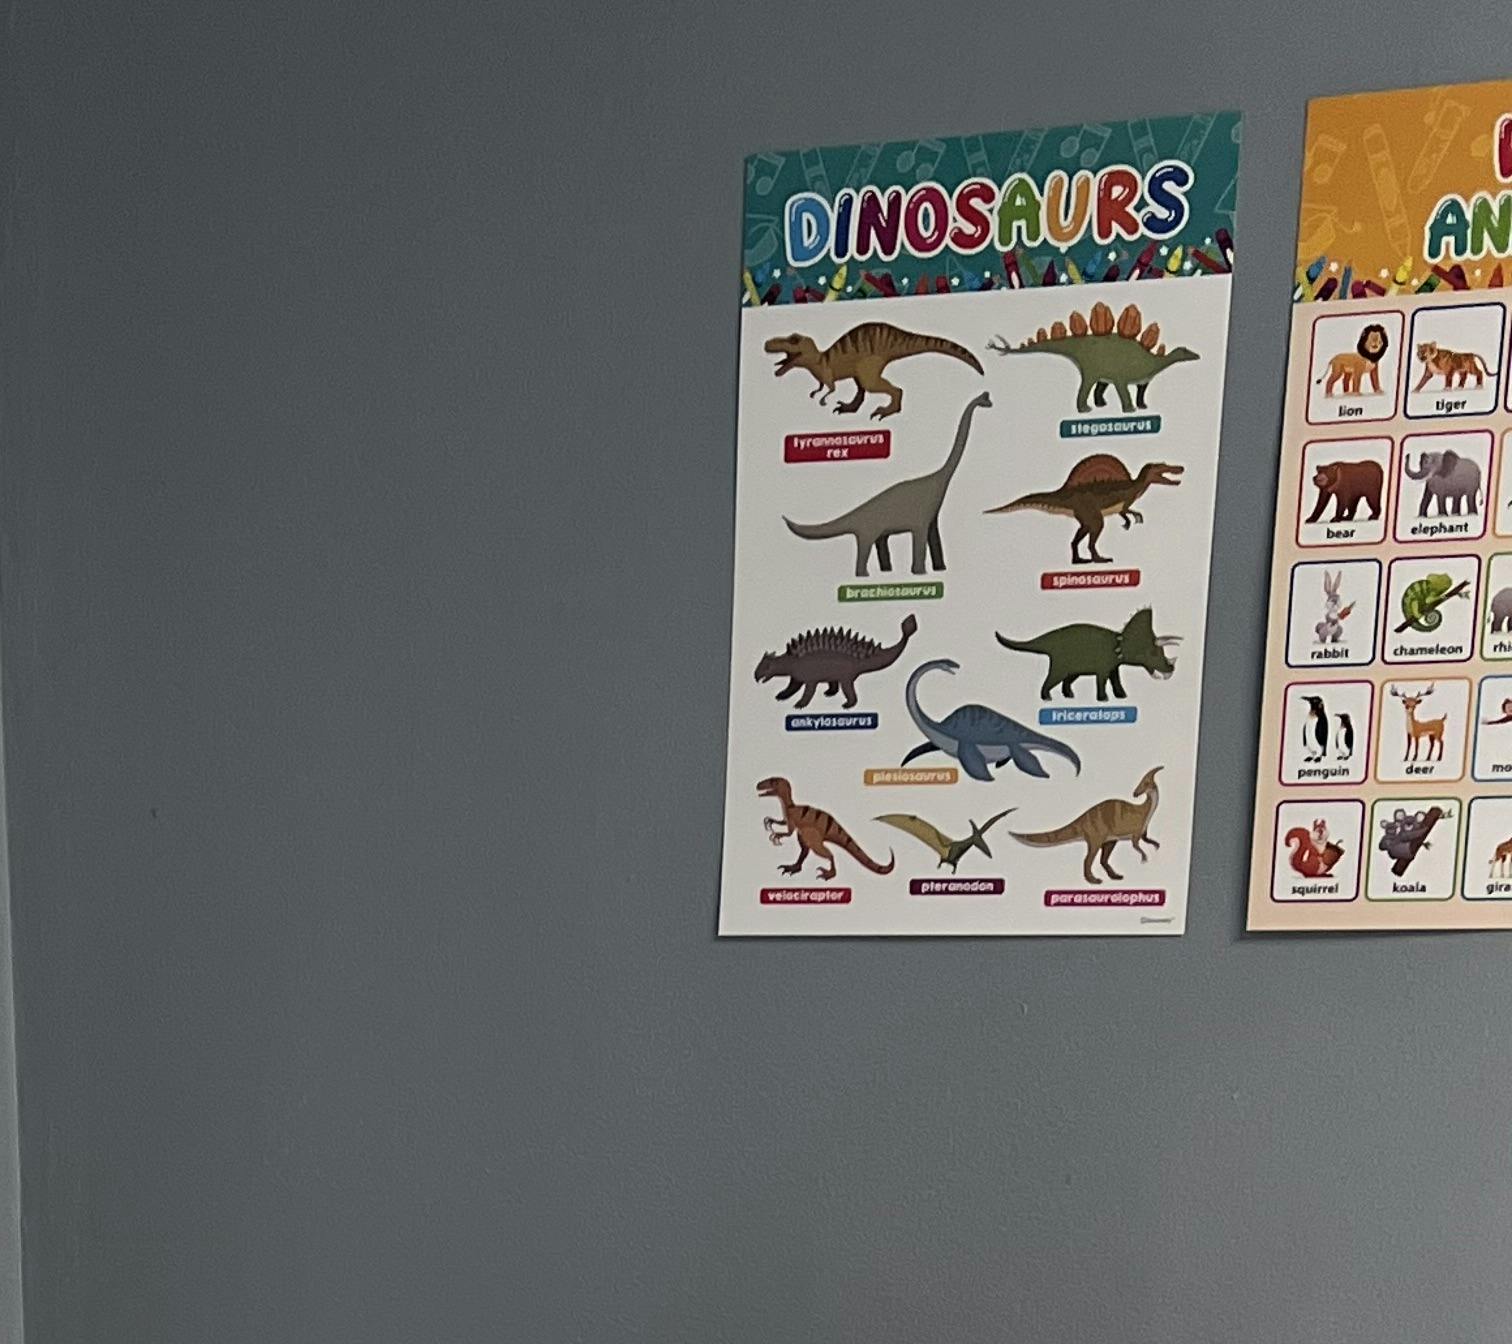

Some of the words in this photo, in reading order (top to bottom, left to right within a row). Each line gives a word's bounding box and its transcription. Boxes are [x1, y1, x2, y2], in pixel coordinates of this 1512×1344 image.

[784, 160, 1195, 267] DINOSAURS
[1338, 405, 1363, 417] lion
[1435, 399, 1468, 414] tiger
[1070, 418, 1152, 437] stegosaurus
[792, 433, 885, 450] tyrannosaurus
[825, 447, 850, 459] rex
[1326, 527, 1356, 540] bear
[1411, 522, 1469, 537] elephant
[1052, 572, 1131, 588] spinosaurus
[845, 583, 938, 599] brachiosaurus
[1310, 647, 1350, 661] rabbit
[1393, 642, 1464, 657] chameleon
[790, 714, 873, 729] ankylosaurus
[1052, 708, 1127, 723] triceratops
[872, 769, 952, 784] plesiosaurus
[1297, 765, 1350, 779] penguin
[1405, 764, 1435, 775] deer
[921, 880, 994, 893] pteranodon
[1291, 884, 1339, 897] squirrel
[1391, 882, 1427, 894] koala
[767, 889, 844, 903] velociraptor
[1050, 891, 1160, 905] parasaurolophus
